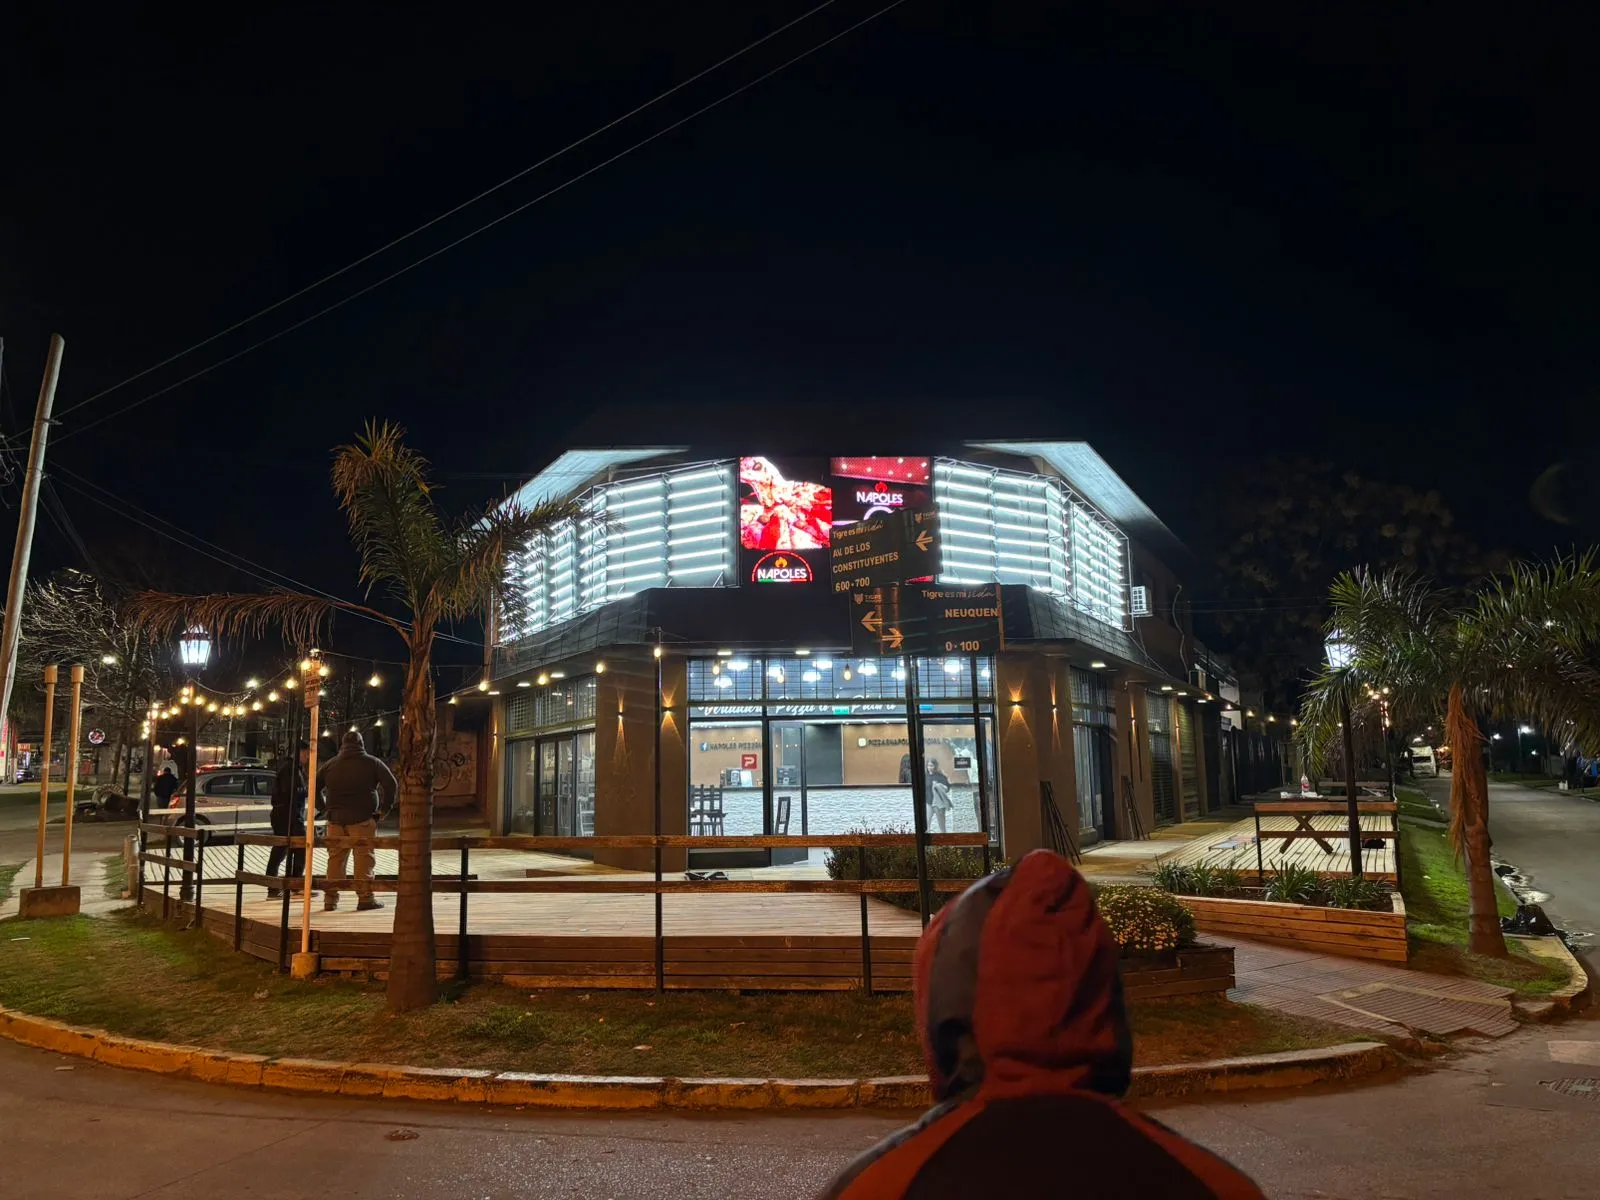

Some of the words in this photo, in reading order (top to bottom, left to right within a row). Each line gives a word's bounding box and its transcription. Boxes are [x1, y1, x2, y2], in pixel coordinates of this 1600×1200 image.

[856, 491, 904, 504] NAPOLES
[844, 545, 855, 555] DE
[855, 541, 871, 553] LOS
[832, 551, 900, 574] CONSTITUYENTES
[757, 568, 808, 579] NAPOLES
[921, 589, 944, 600] Tigre
[944, 607, 999, 618] NEUQUEN
